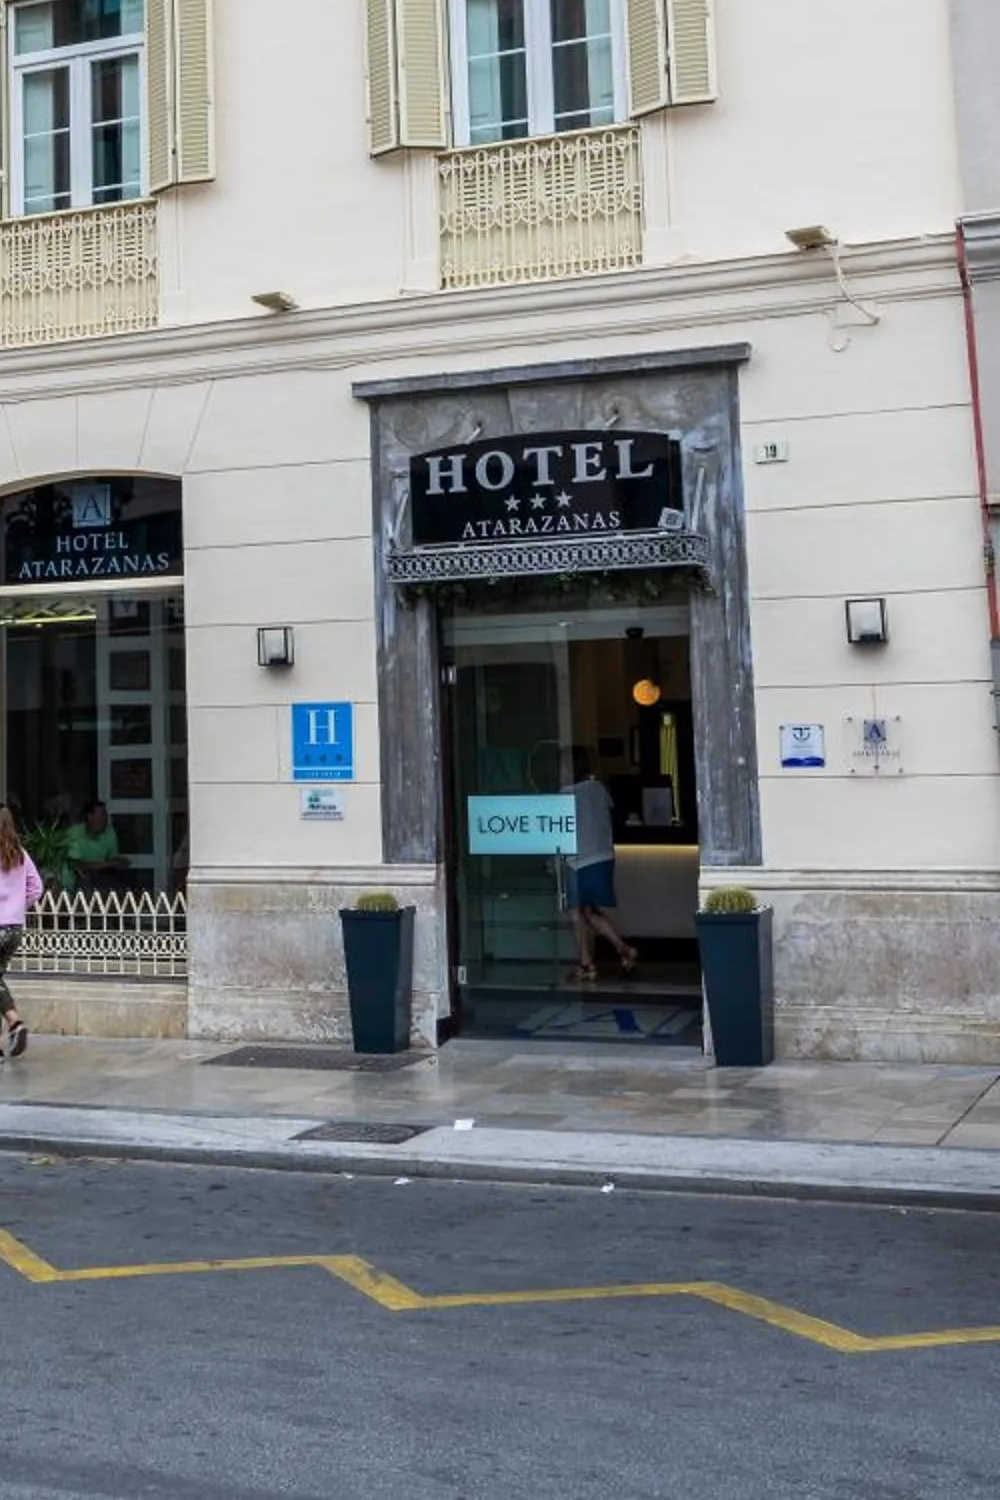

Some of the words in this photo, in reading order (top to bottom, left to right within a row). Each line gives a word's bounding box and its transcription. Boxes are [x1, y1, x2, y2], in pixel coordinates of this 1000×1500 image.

[424, 439, 655, 495] HOTEL
[462, 511, 622, 539] ATARAZANAS
[56, 531, 129, 553] HOTEL
[19, 552, 169, 579] ATARAZANAS
[304, 708, 341, 745] H
[478, 815, 530, 834] LOVE
[536, 815, 575, 833] THE
